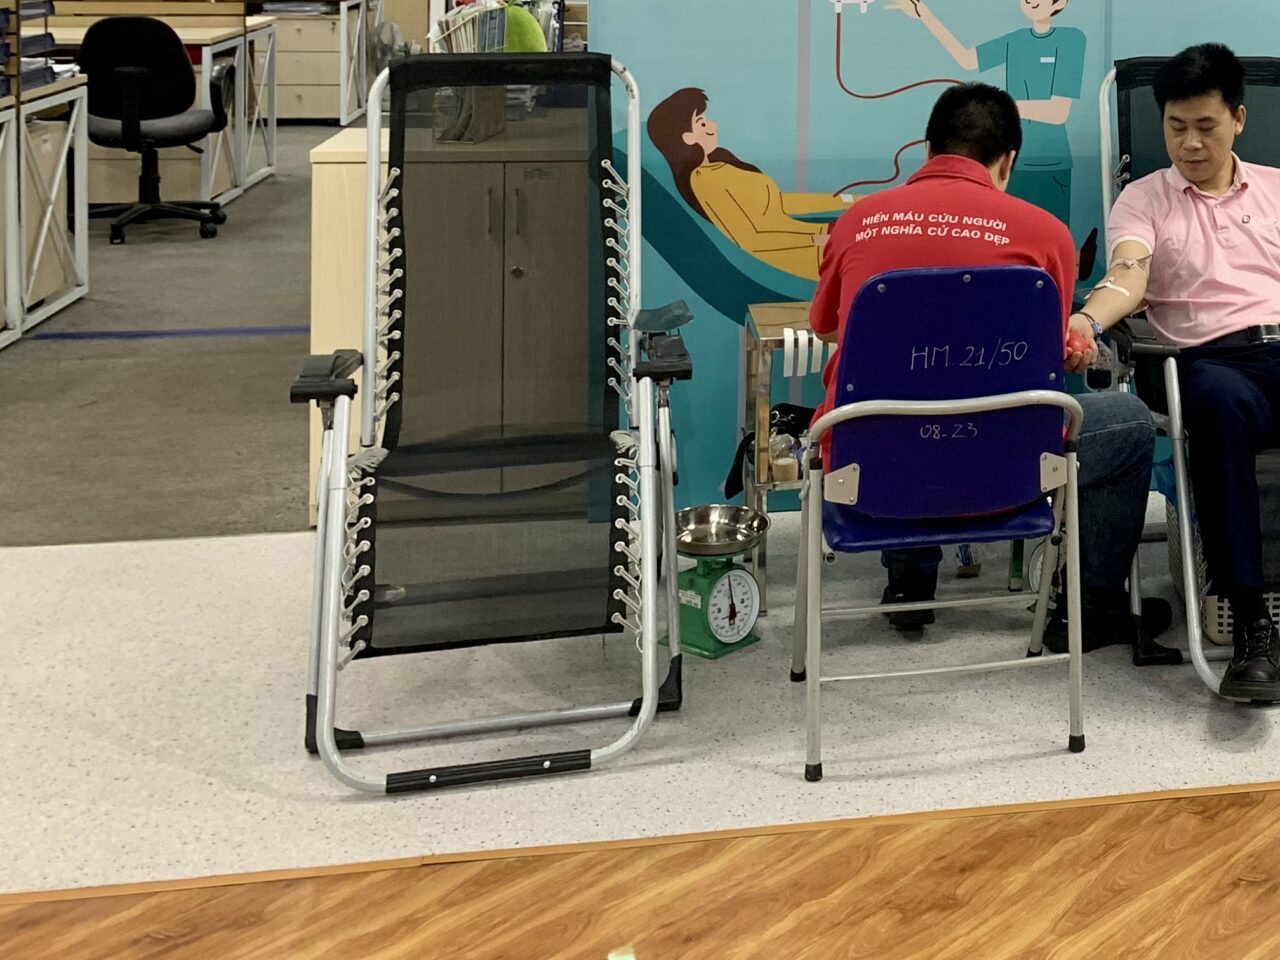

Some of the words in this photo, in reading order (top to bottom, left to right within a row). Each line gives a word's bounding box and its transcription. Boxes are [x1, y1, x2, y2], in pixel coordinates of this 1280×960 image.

[862, 211, 890, 227] HIẾN
[892, 210, 925, 222] MÁU
[928, 212, 959, 224] CỨU
[962, 216, 1007, 232] NGƯỜI
[855, 227, 879, 243] MỘT
[881, 223, 923, 236] NGHĨA
[927, 225, 949, 237] CỬ
[951, 228, 981, 239] CAO
[984, 231, 1010, 247] ĐẸP
